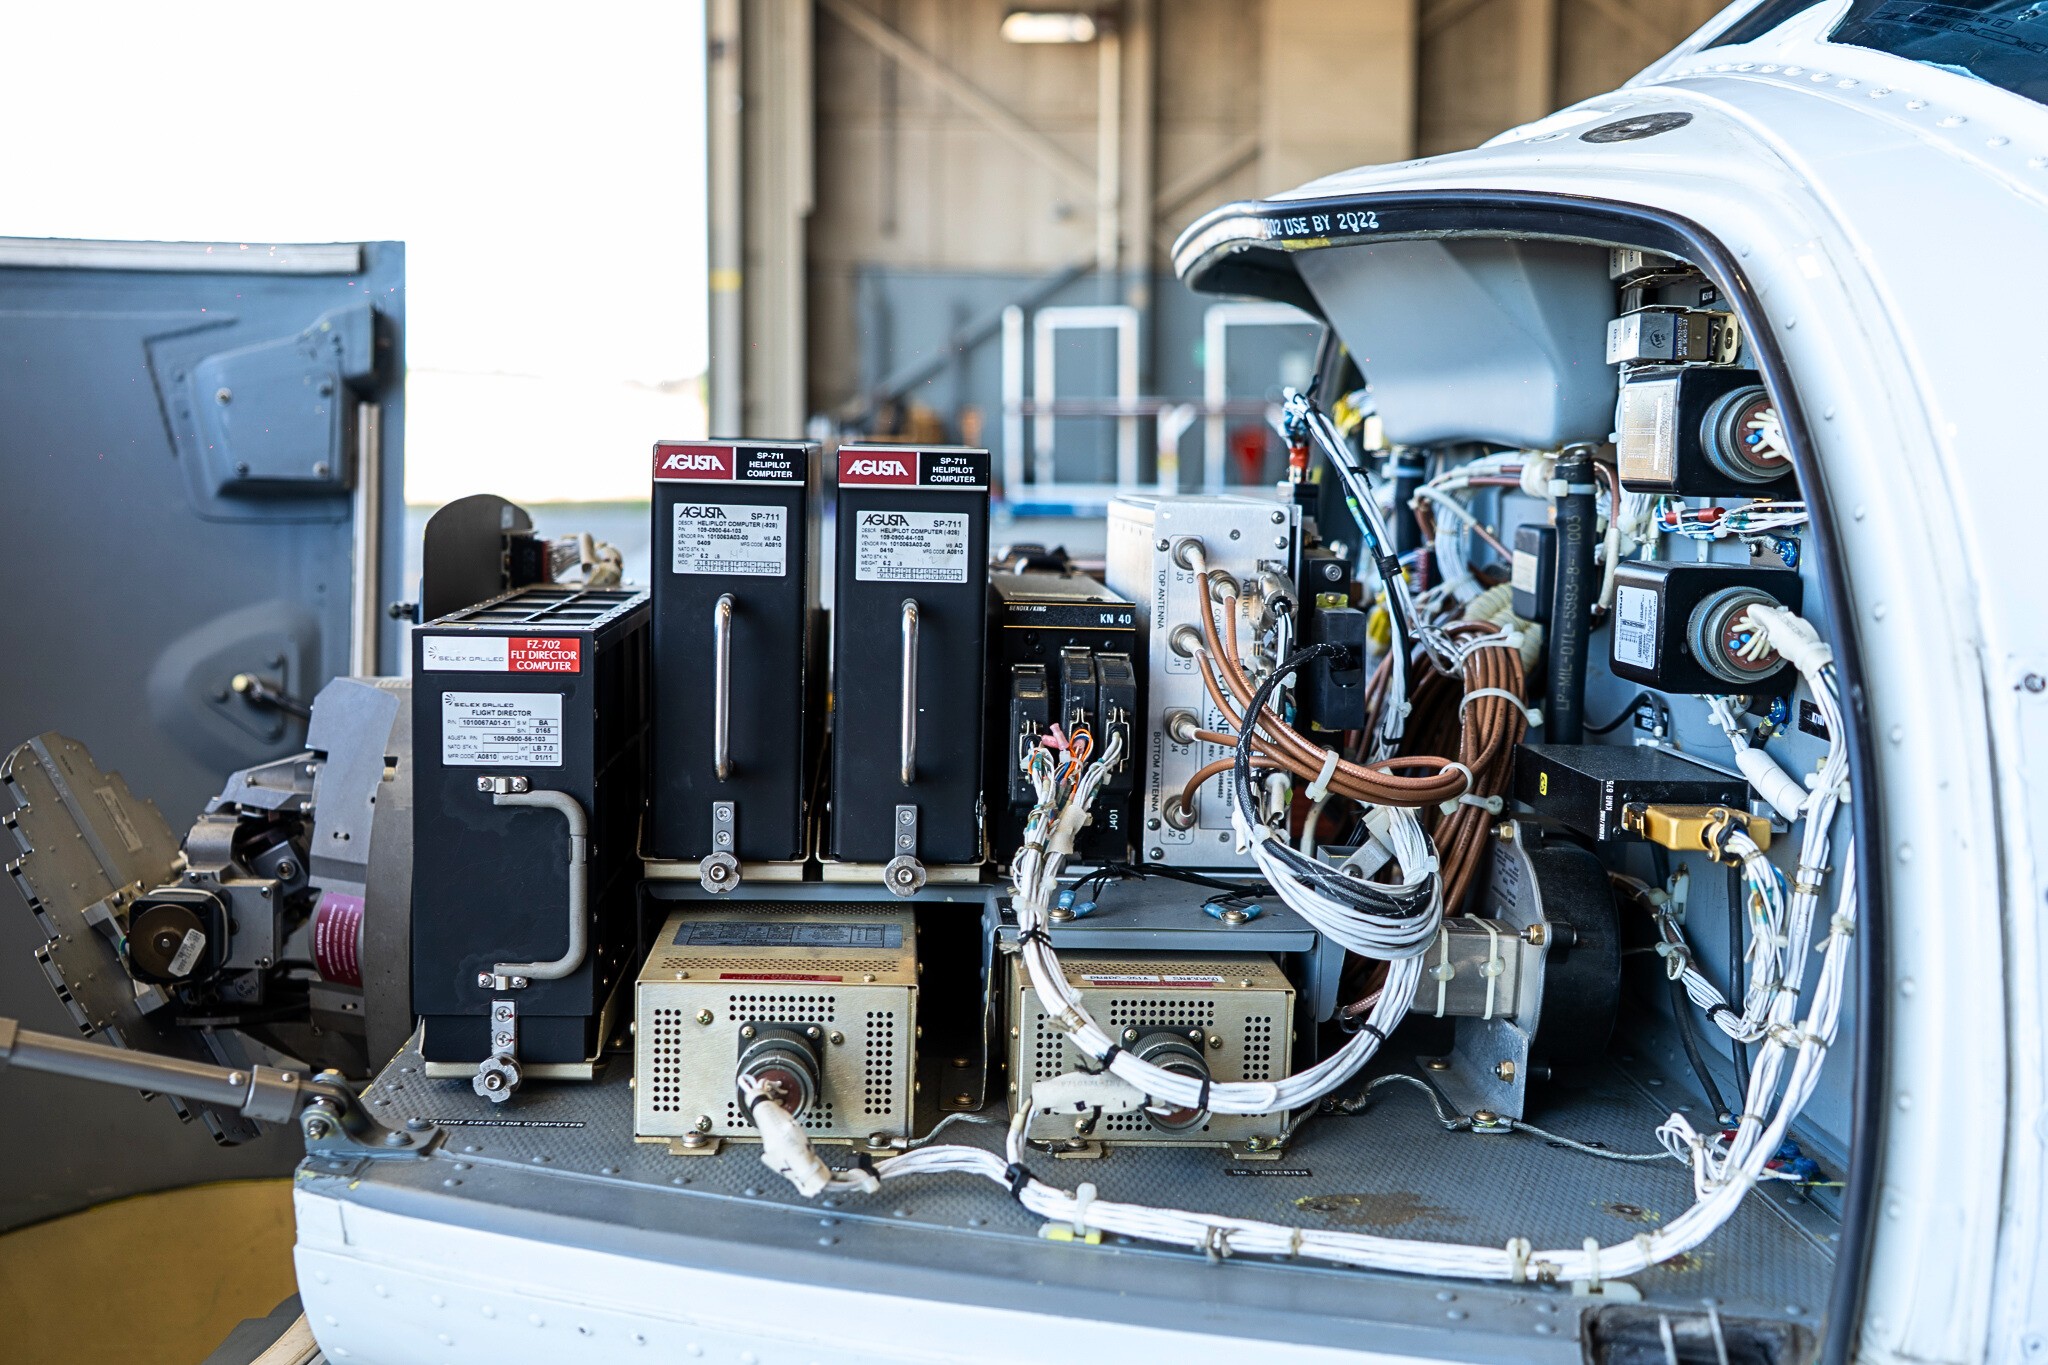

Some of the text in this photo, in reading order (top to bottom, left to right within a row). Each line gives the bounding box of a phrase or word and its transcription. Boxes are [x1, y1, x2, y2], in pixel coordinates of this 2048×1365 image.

[1283, 216, 1310, 235] USE
[1311, 214, 1330, 232] BY
[756, 452, 784, 460] SP-711
[940, 457, 967, 465] SP-711
[661, 454, 725, 471] AGUSTA
[749, 460, 791, 469] HELIPILOT
[846, 459, 909, 476] AGUSTA
[746, 469, 793, 478] COMPUTER
[932, 466, 974, 474] HELIPILOT
[930, 475, 976, 483] COMPUTER
[678, 506, 727, 519] AGUSTA
[751, 513, 780, 521] SP-711
[861, 514, 910, 527] AGUSTA
[933, 519, 962, 528] SP-711
[1176, 571, 1184, 582] J3
[1186, 571, 1194, 584] TO
[1157, 569, 1166, 630] TOP ANTENNA
[1100, 613, 1132, 625] KN 40
[526, 640, 561, 649] FZ-702
[510, 650, 578, 661] FLT DIRECTOR
[516, 660, 572, 671] COMPUTER
[1184, 657, 1192, 670] TO
[1171, 743, 1179, 753] J4
[1181, 743, 1189, 756] TO
[1151, 731, 1161, 813] BOTTOM ANTENNA
[1605, 795, 1614, 811] KMR
[1109, 809, 1119, 831] J401
[1168, 828, 1176, 838] J2
